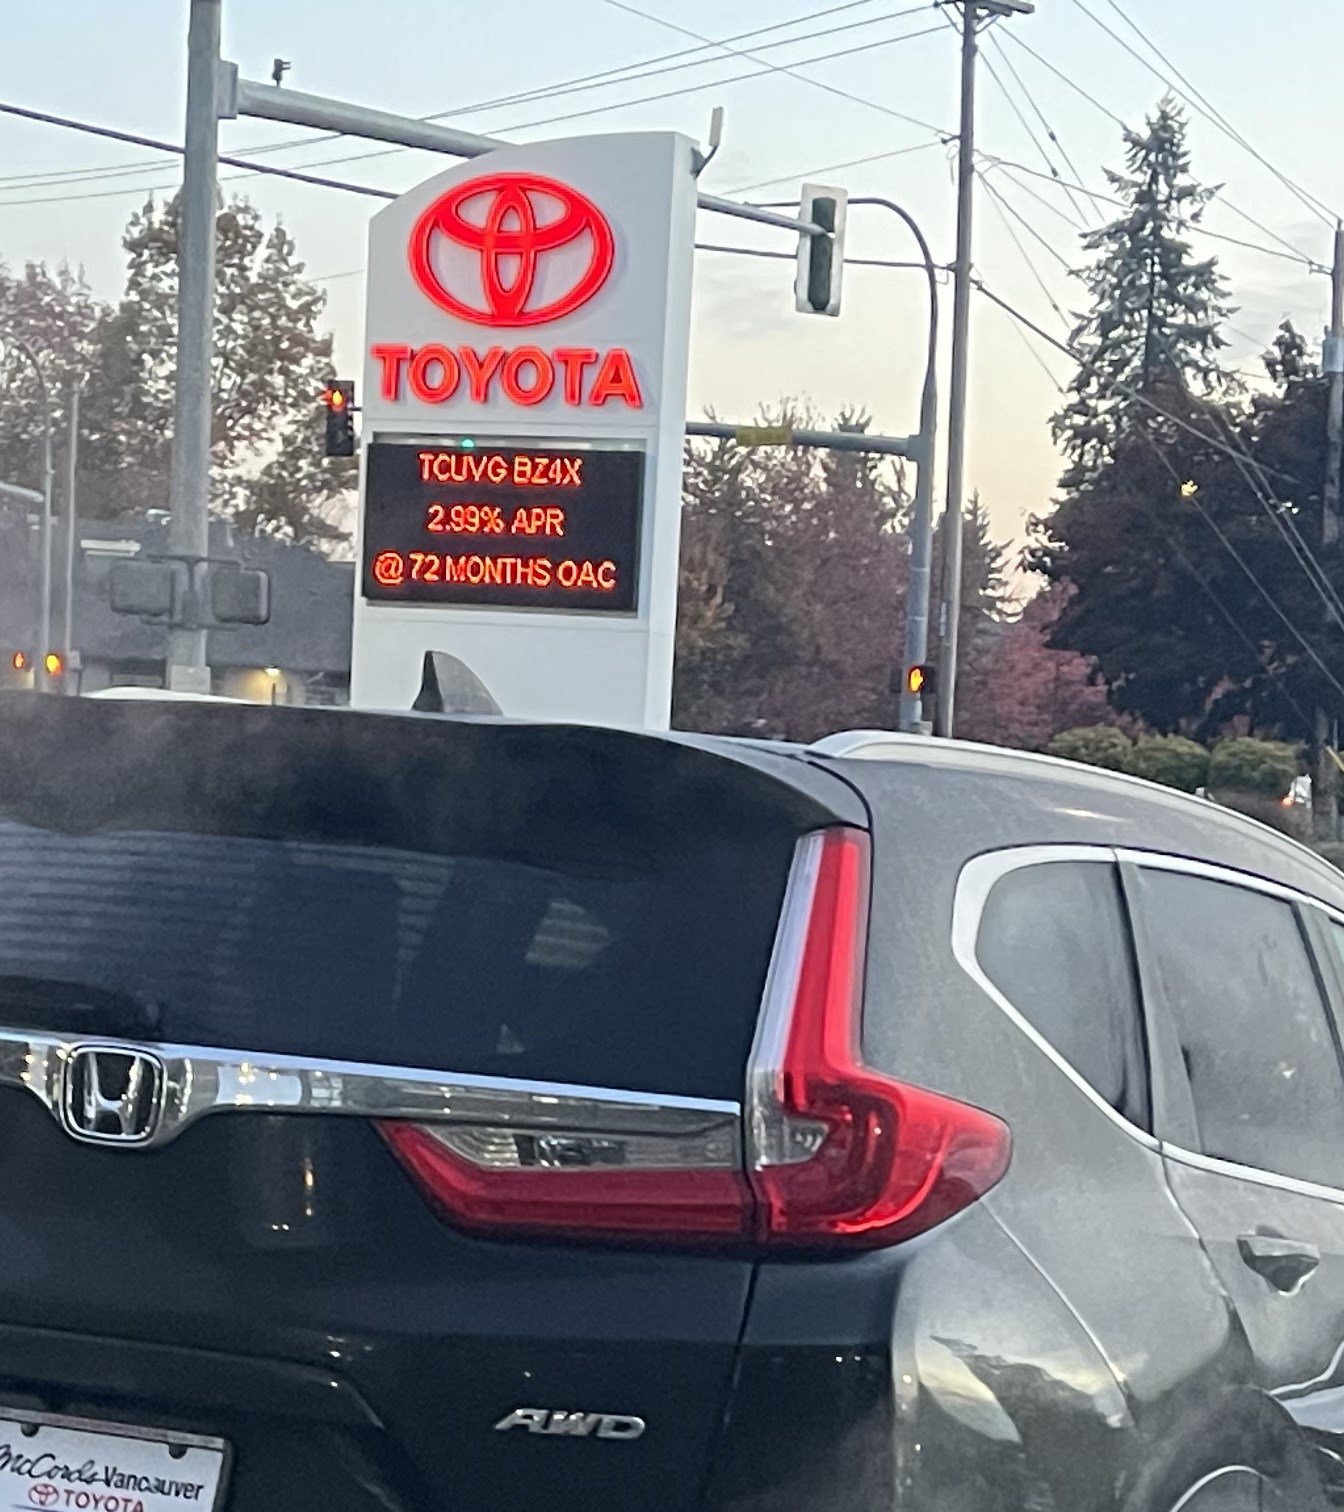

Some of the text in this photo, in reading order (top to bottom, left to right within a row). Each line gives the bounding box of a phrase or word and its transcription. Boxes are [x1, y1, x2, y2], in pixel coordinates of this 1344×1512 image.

[371, 343, 644, 409] TOYOTA
[418, 452, 584, 487] TCUVG BZ4X
[427, 504, 566, 537] 2.99% APR
[374, 551, 617, 590] @ 72 MONTHS OAC
[494, 1407, 646, 1440] AWD
